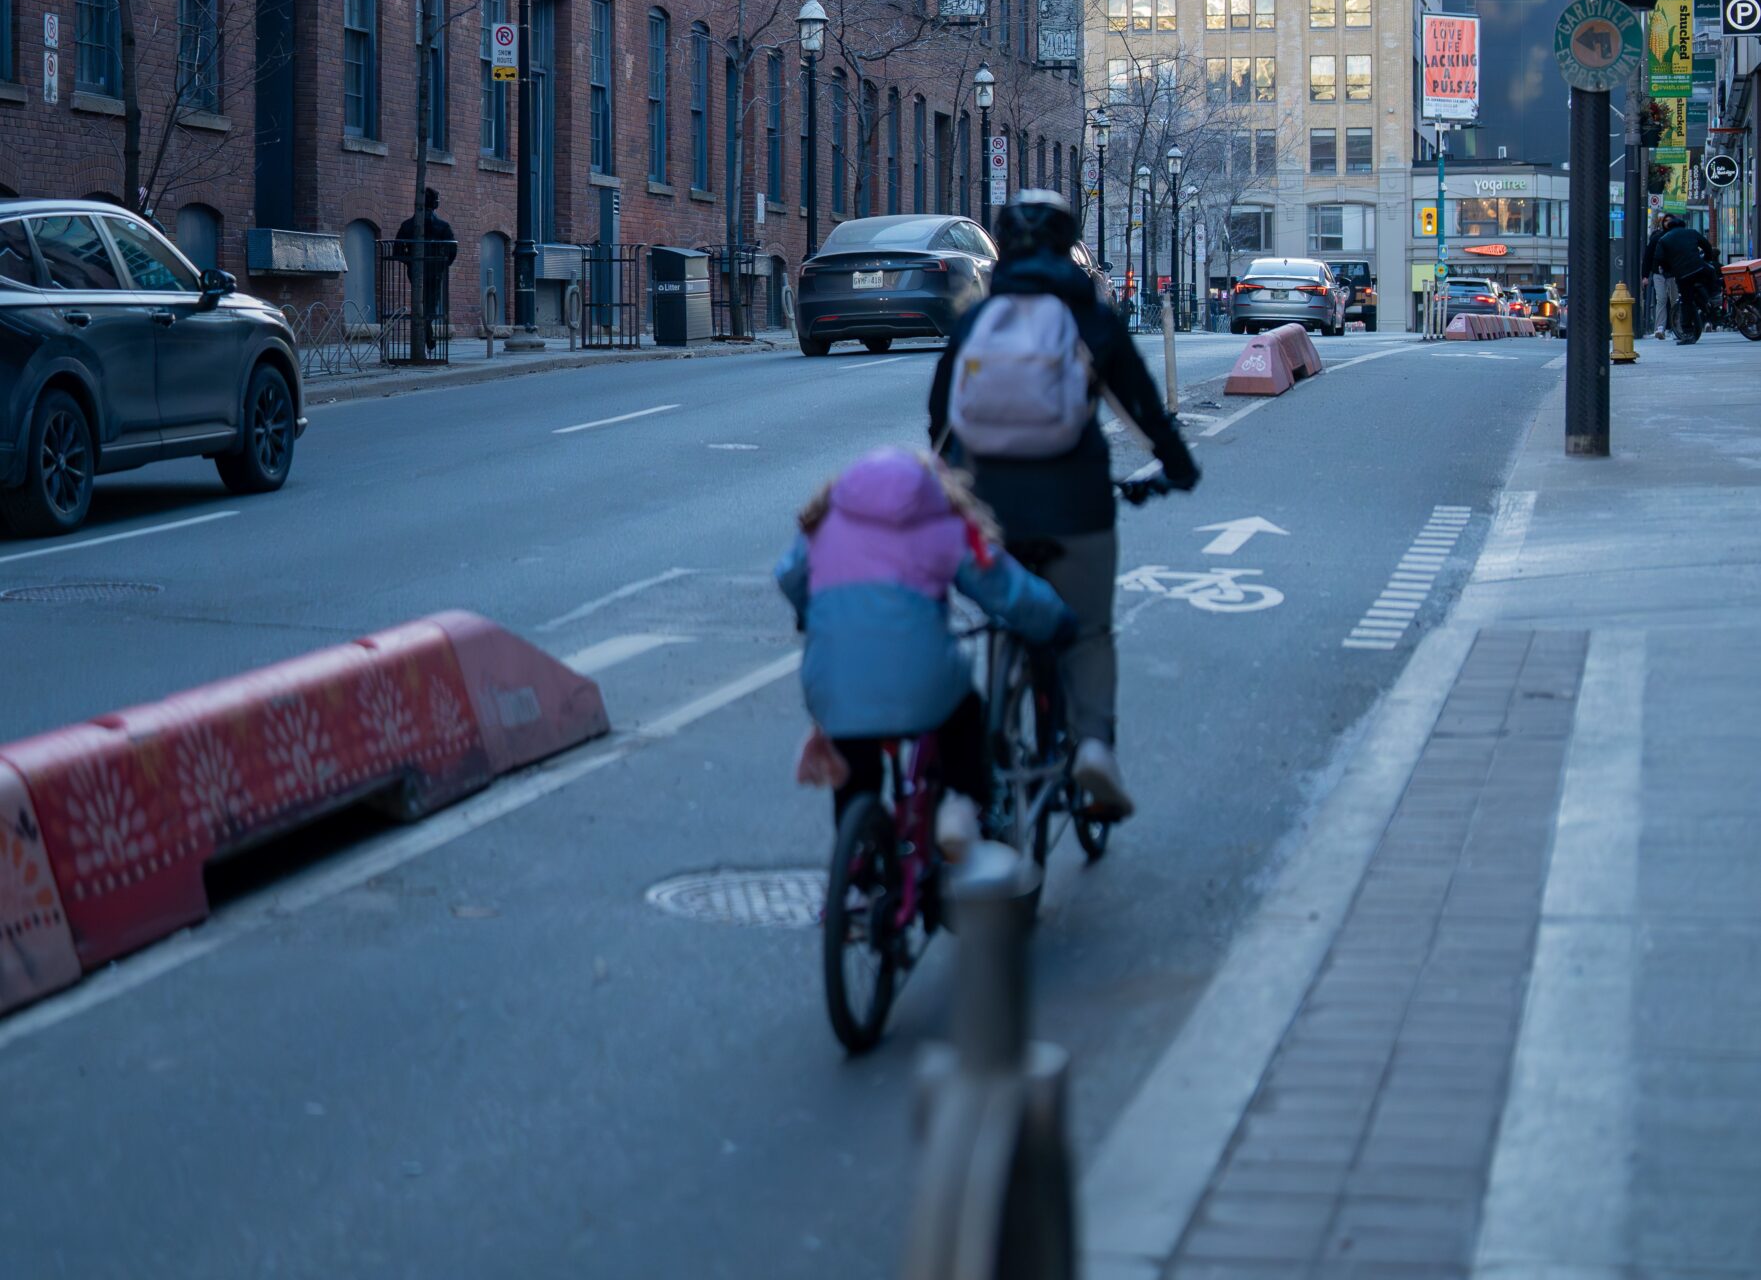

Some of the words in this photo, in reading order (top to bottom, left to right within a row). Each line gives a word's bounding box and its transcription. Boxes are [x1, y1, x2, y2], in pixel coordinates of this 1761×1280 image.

[1433, 29, 1462, 40] LOVE
[1680, 5, 1690, 60] shucked
[1045, 32, 1073, 56] 401
[1436, 41, 1460, 53] LIFE
[1424, 54, 1478, 68] LACKING
[1556, 44, 1641, 89] EXPRESSWAY
[1444, 68, 1451, 79] A
[1432, 80, 1477, 94] PULSE?
[1474, 178, 1527, 196] yogatree
[665, 283, 680, 291] Litter
